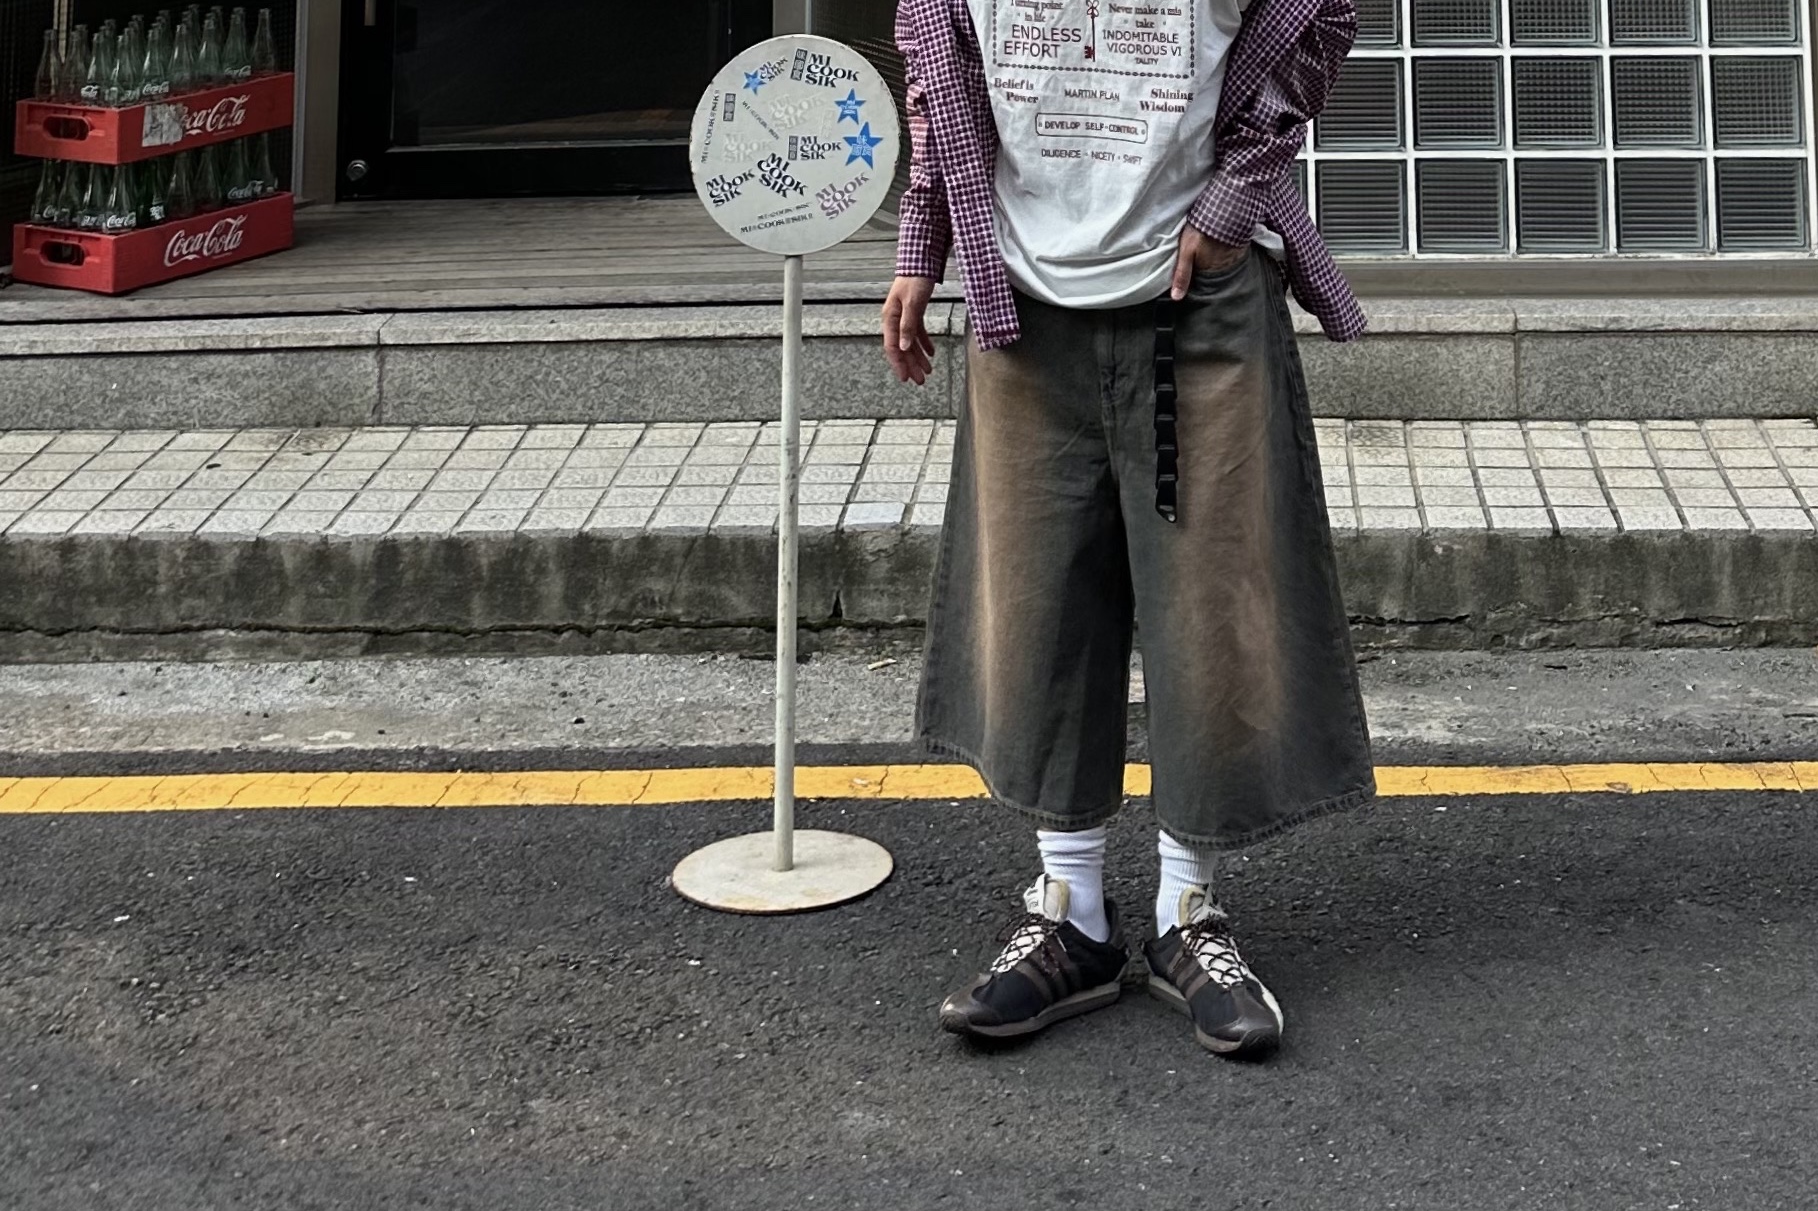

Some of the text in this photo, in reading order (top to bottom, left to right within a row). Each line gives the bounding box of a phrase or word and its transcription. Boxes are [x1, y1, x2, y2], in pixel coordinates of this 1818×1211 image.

[1012, 23, 1082, 42] ENDLESS
[1103, 29, 1179, 44] INDOMITABLE
[1004, 40, 1061, 58] EFFORT
[1107, 43, 1168, 56] VIGOROUS
[809, 53, 831, 67] MI
[804, 73, 837, 88] SIK
[807, 63, 860, 83] COOK
[994, 77, 1025, 90] Belief
[1006, 91, 1039, 103] Power
[1064, 88, 1098, 99] MARTIN
[1151, 88, 1195, 103] Shining
[1139, 100, 1185, 113] Wisdom
[1044, 121, 1080, 130] DEVELOP
[800, 142, 842, 153] COOK
[801, 136, 818, 145] MI
[766, 152, 791, 172] MI
[801, 151, 826, 161] SIK
[706, 174, 726, 190] MI
[709, 168, 756, 199] COOK
[757, 159, 809, 196] COOK
[759, 172, 788, 199] SIK
[815, 183, 837, 203] MI
[820, 172, 870, 211] COOK
[713, 188, 742, 208] SIK
[825, 194, 858, 220] SIK
